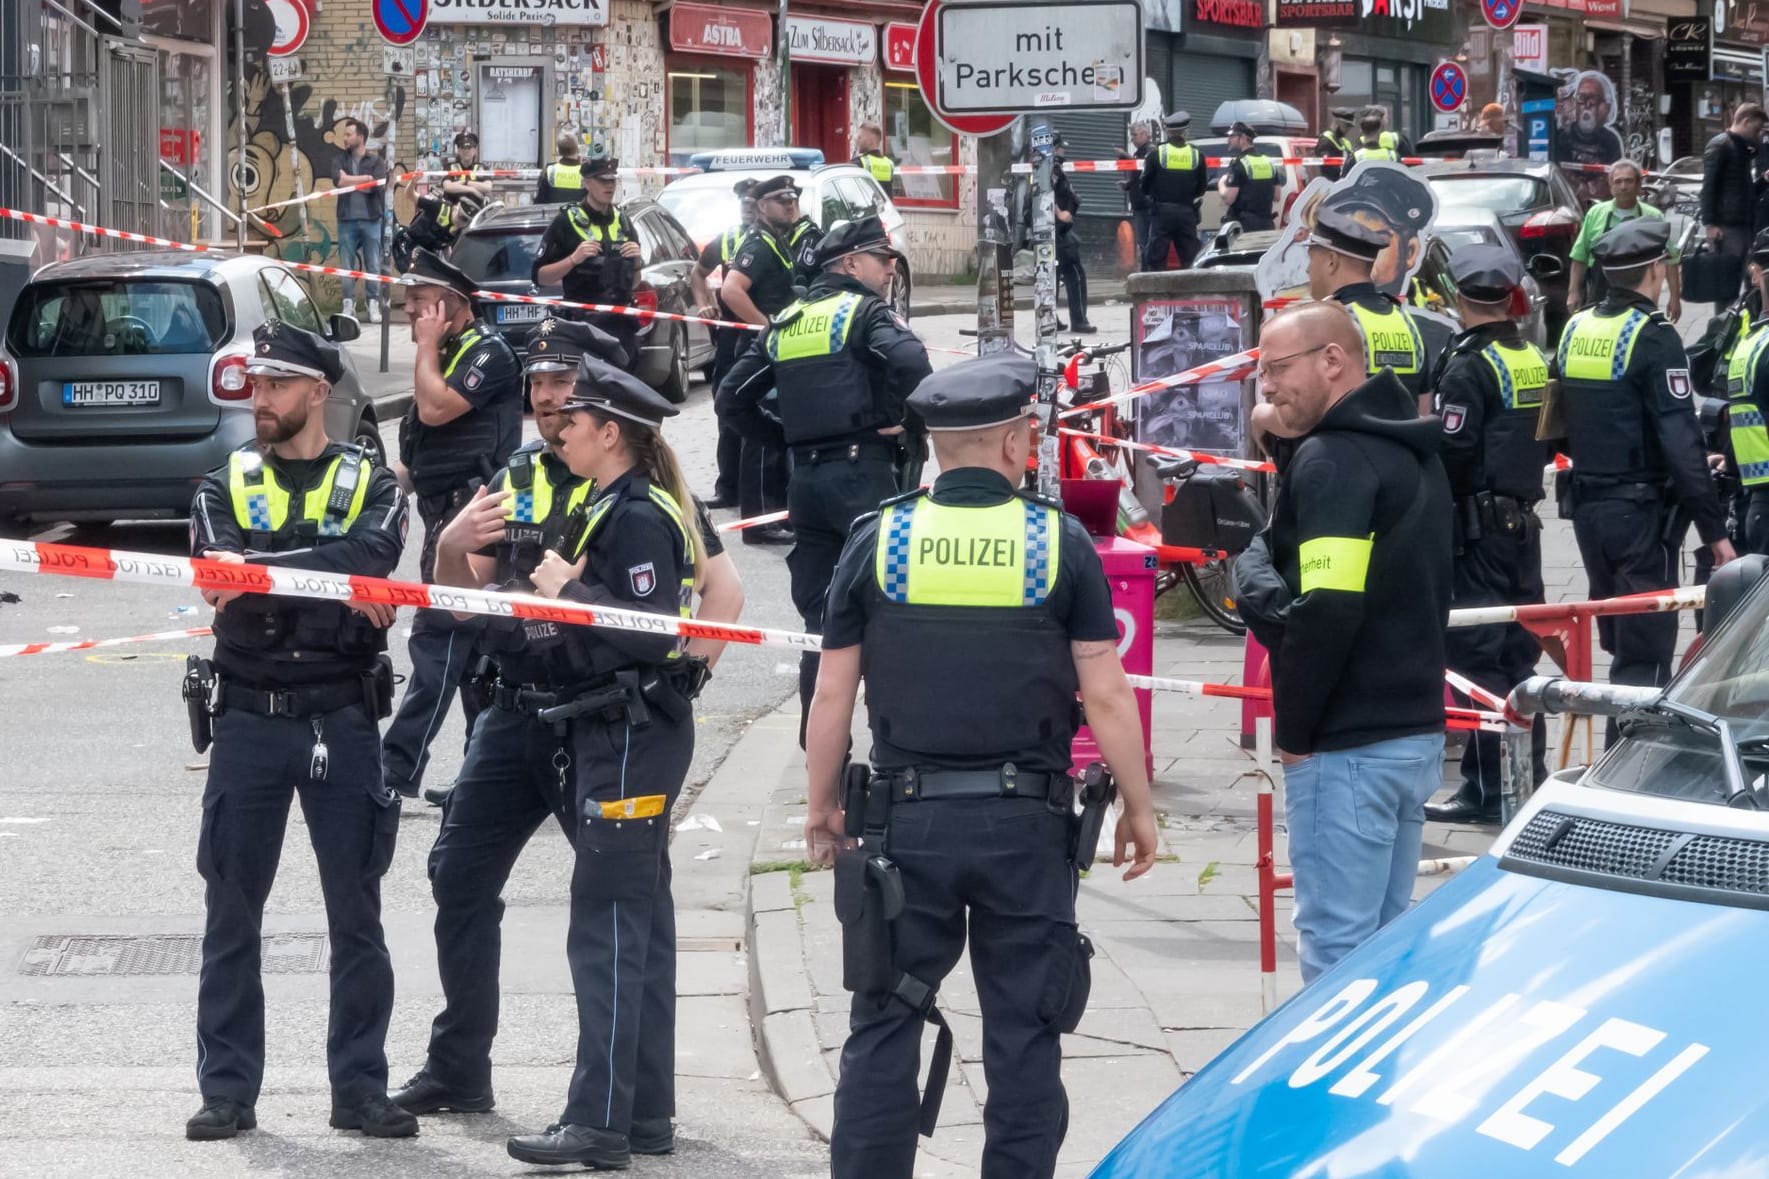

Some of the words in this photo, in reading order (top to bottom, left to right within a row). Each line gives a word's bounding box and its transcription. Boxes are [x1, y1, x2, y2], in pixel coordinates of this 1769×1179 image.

[487, 11, 516, 20] Solide
[519, 11, 545, 21] Preis
[1280, 4, 1354, 17] SPORTSBAR
[1588, 2, 1616, 12] West
[702, 24, 742, 47] ASTRA
[1016, 26, 1063, 52] mit
[1515, 32, 1539, 57] Bild
[956, 60, 1125, 89] Parksche
[1531, 120, 1546, 137] P
[715, 154, 788, 165] FEUERWEHR
[505, 307, 519, 319] HH
[527, 306, 541, 318] HF
[782, 315, 828, 339] POLIZEI
[1372, 332, 1412, 350] POLIZEI
[1570, 336, 1614, 358] POLIZEI
[73, 384, 94, 400] HH
[105, 384, 125, 399] PQ
[128, 383, 158, 398] 310
[919, 537, 1016, 567] POLIZEI
[1231, 978, 1711, 1167] POLIZEI
